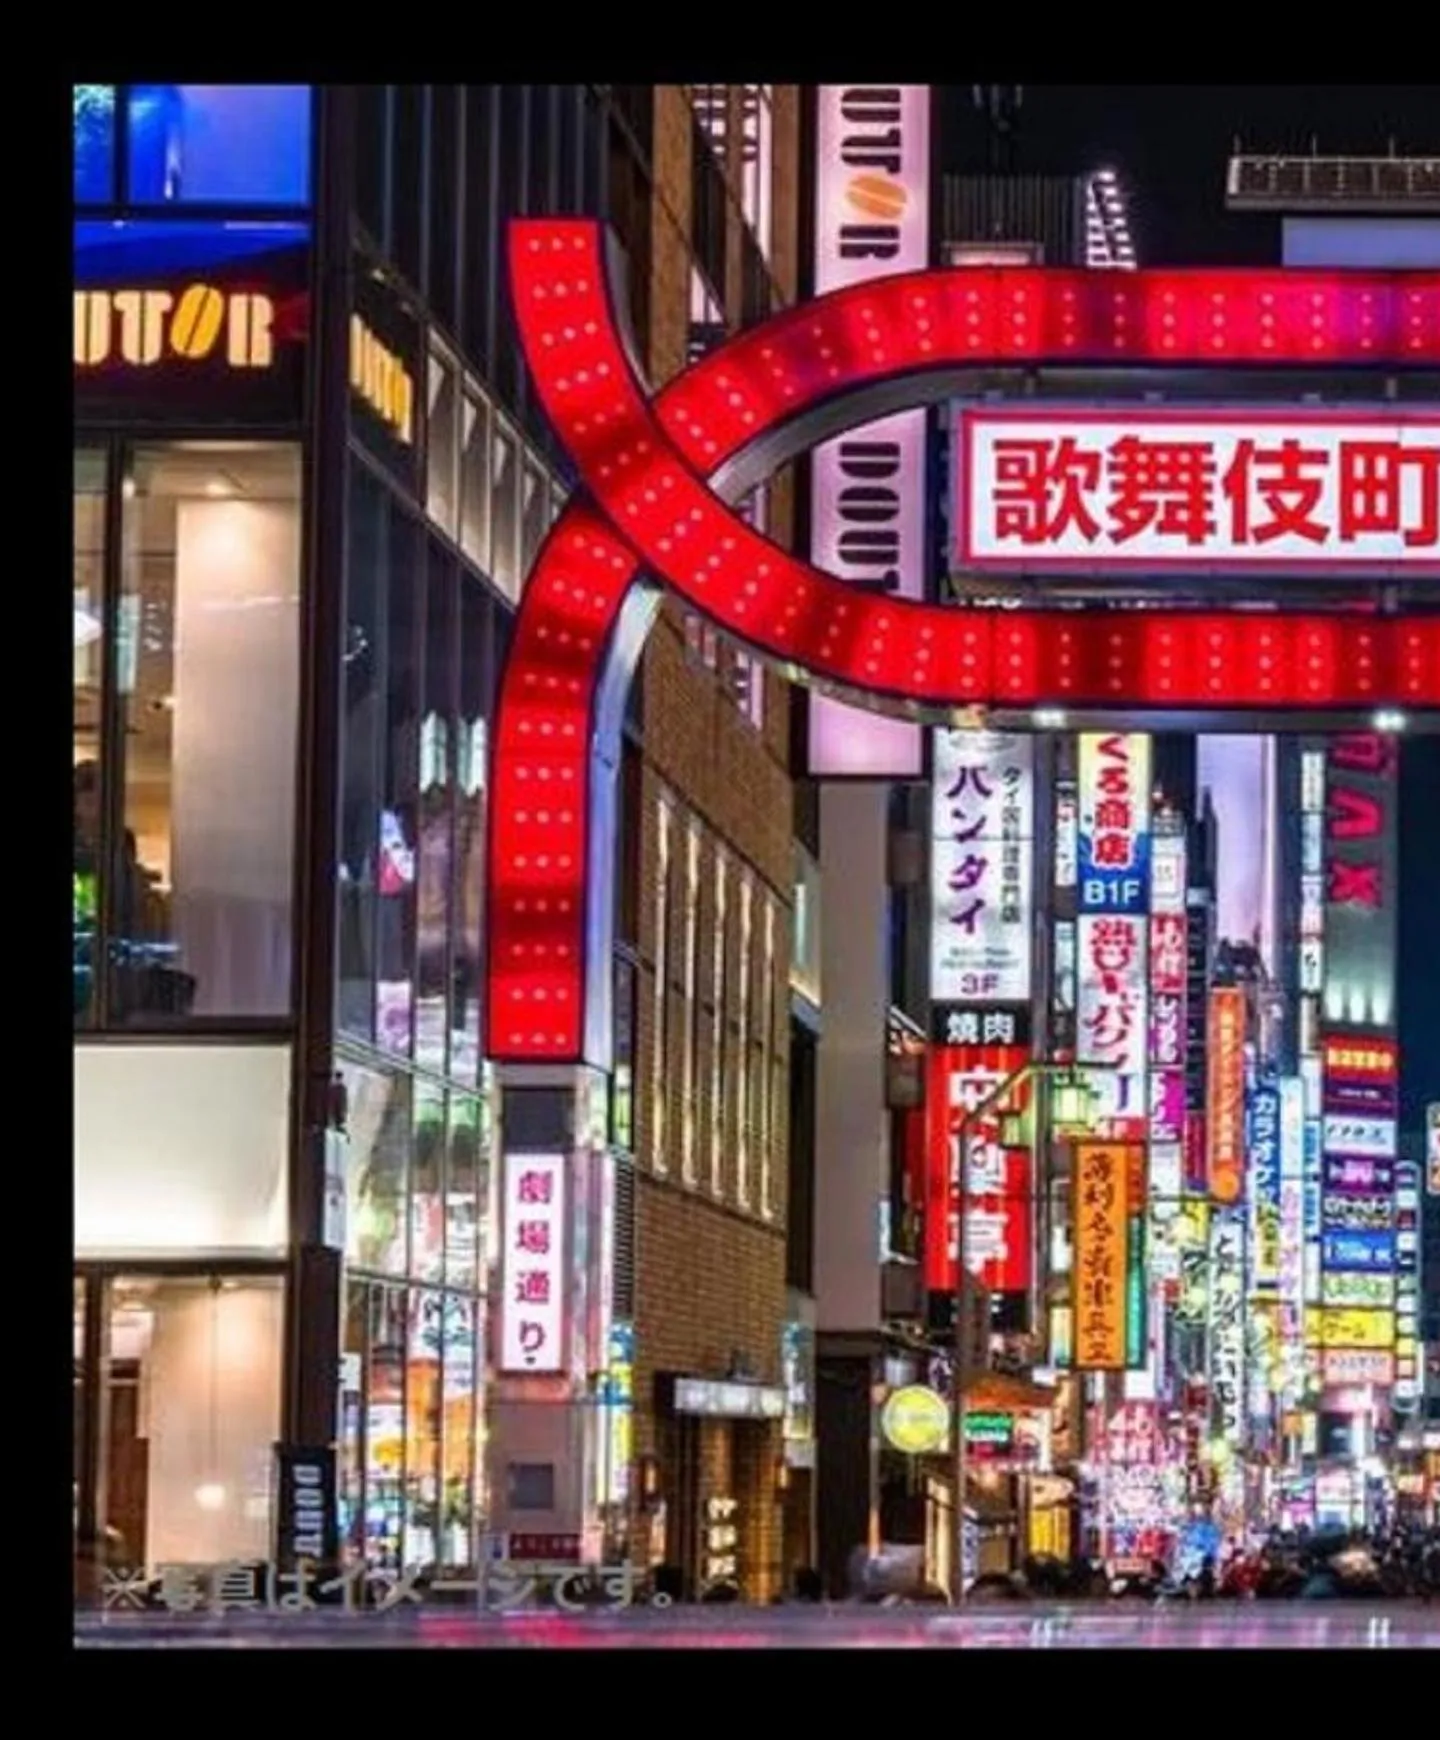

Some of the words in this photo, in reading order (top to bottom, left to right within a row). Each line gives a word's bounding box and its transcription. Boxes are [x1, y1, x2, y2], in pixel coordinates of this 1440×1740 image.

[1084, 880, 1141, 905] B1F
[960, 973, 999, 995] 3F
[947, 1011, 1014, 1045] 焼肉
[515, 1169, 552, 1353] 劇場通り
